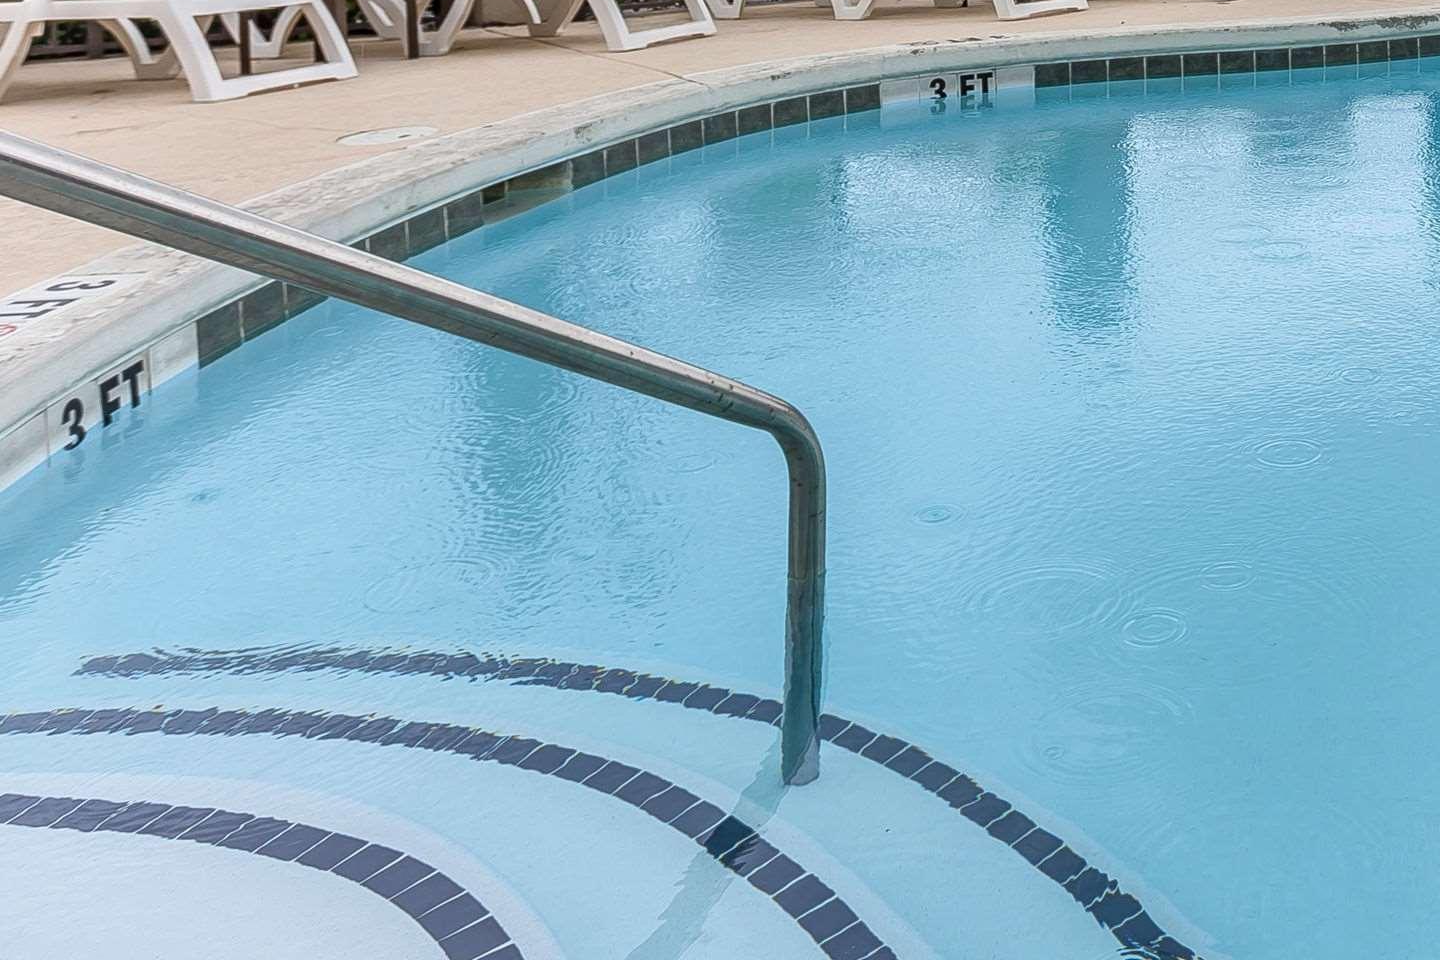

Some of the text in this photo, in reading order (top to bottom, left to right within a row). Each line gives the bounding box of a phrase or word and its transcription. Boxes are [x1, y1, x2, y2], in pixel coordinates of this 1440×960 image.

[929, 72, 993, 100] 3 FT
[46, 280, 117, 291] 3
[61, 360, 145, 451] 3 FT
